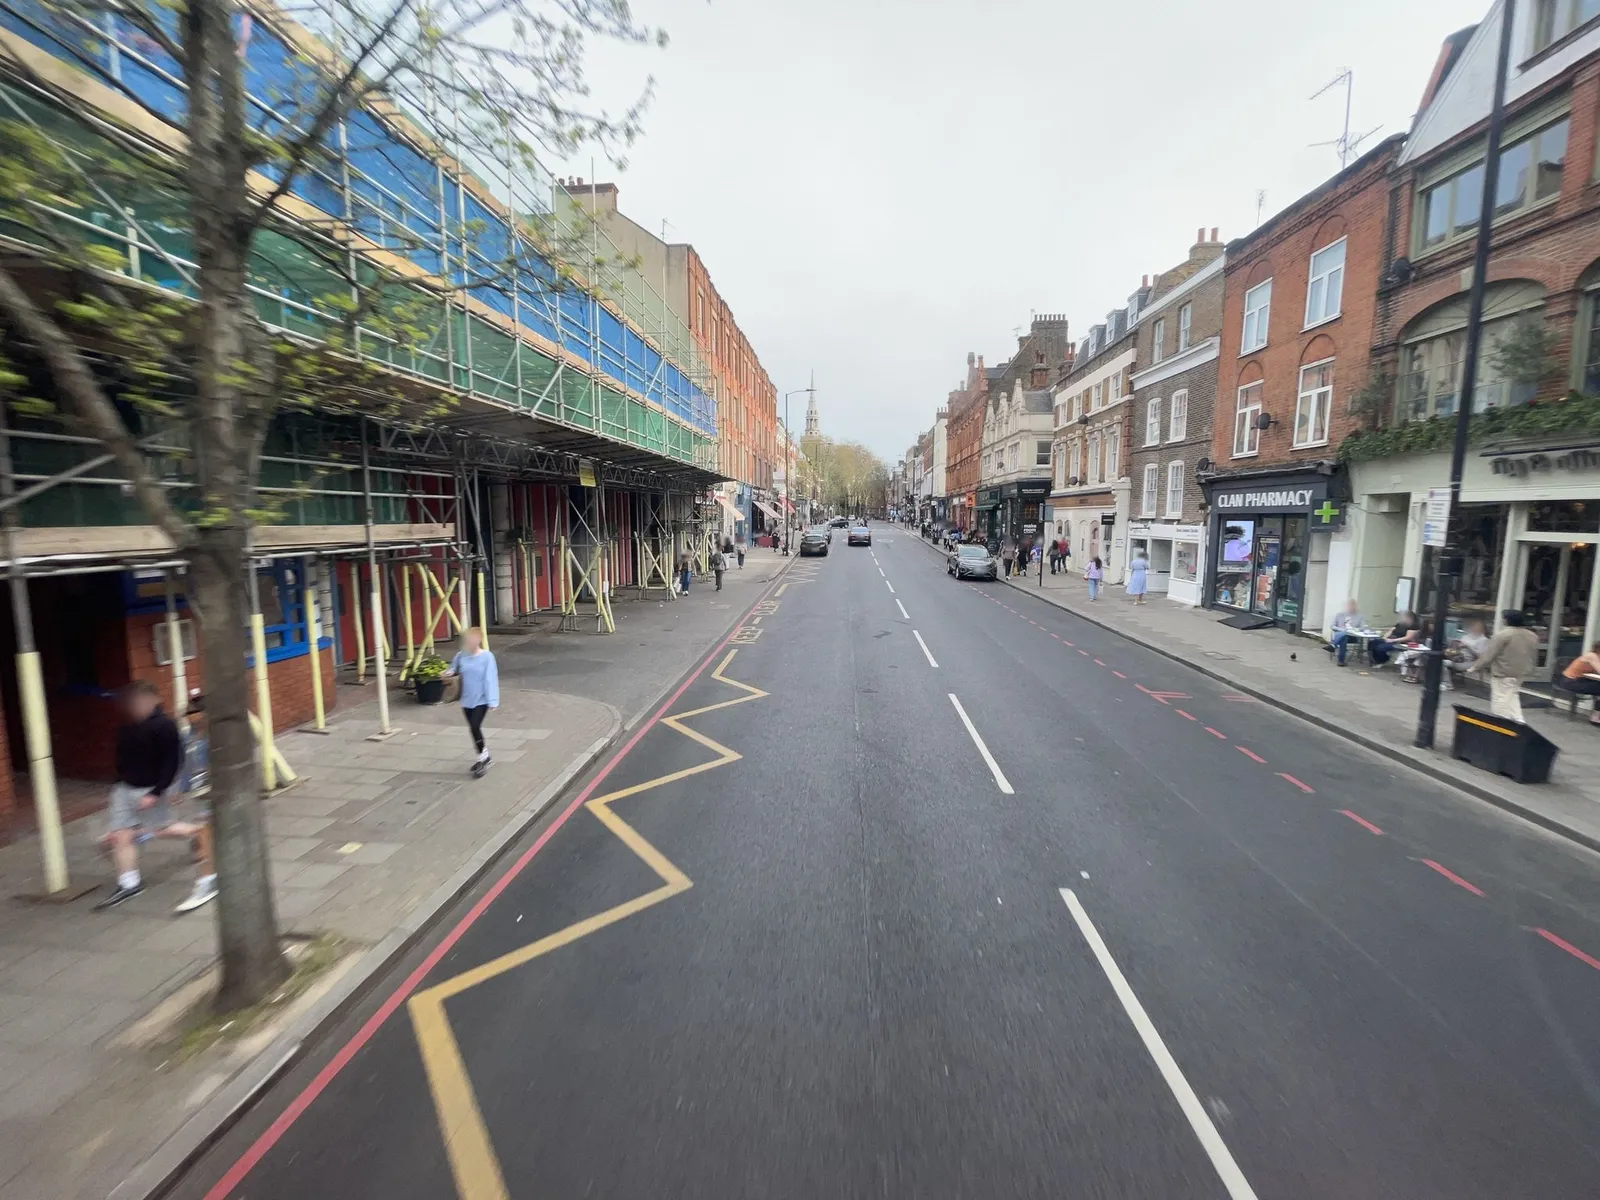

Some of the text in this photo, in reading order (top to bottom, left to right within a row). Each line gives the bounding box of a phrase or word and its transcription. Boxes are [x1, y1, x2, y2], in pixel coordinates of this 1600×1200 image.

[1218, 490, 1313, 508] CLAN PHARMACY
[727, 626, 764, 645] KEEP
